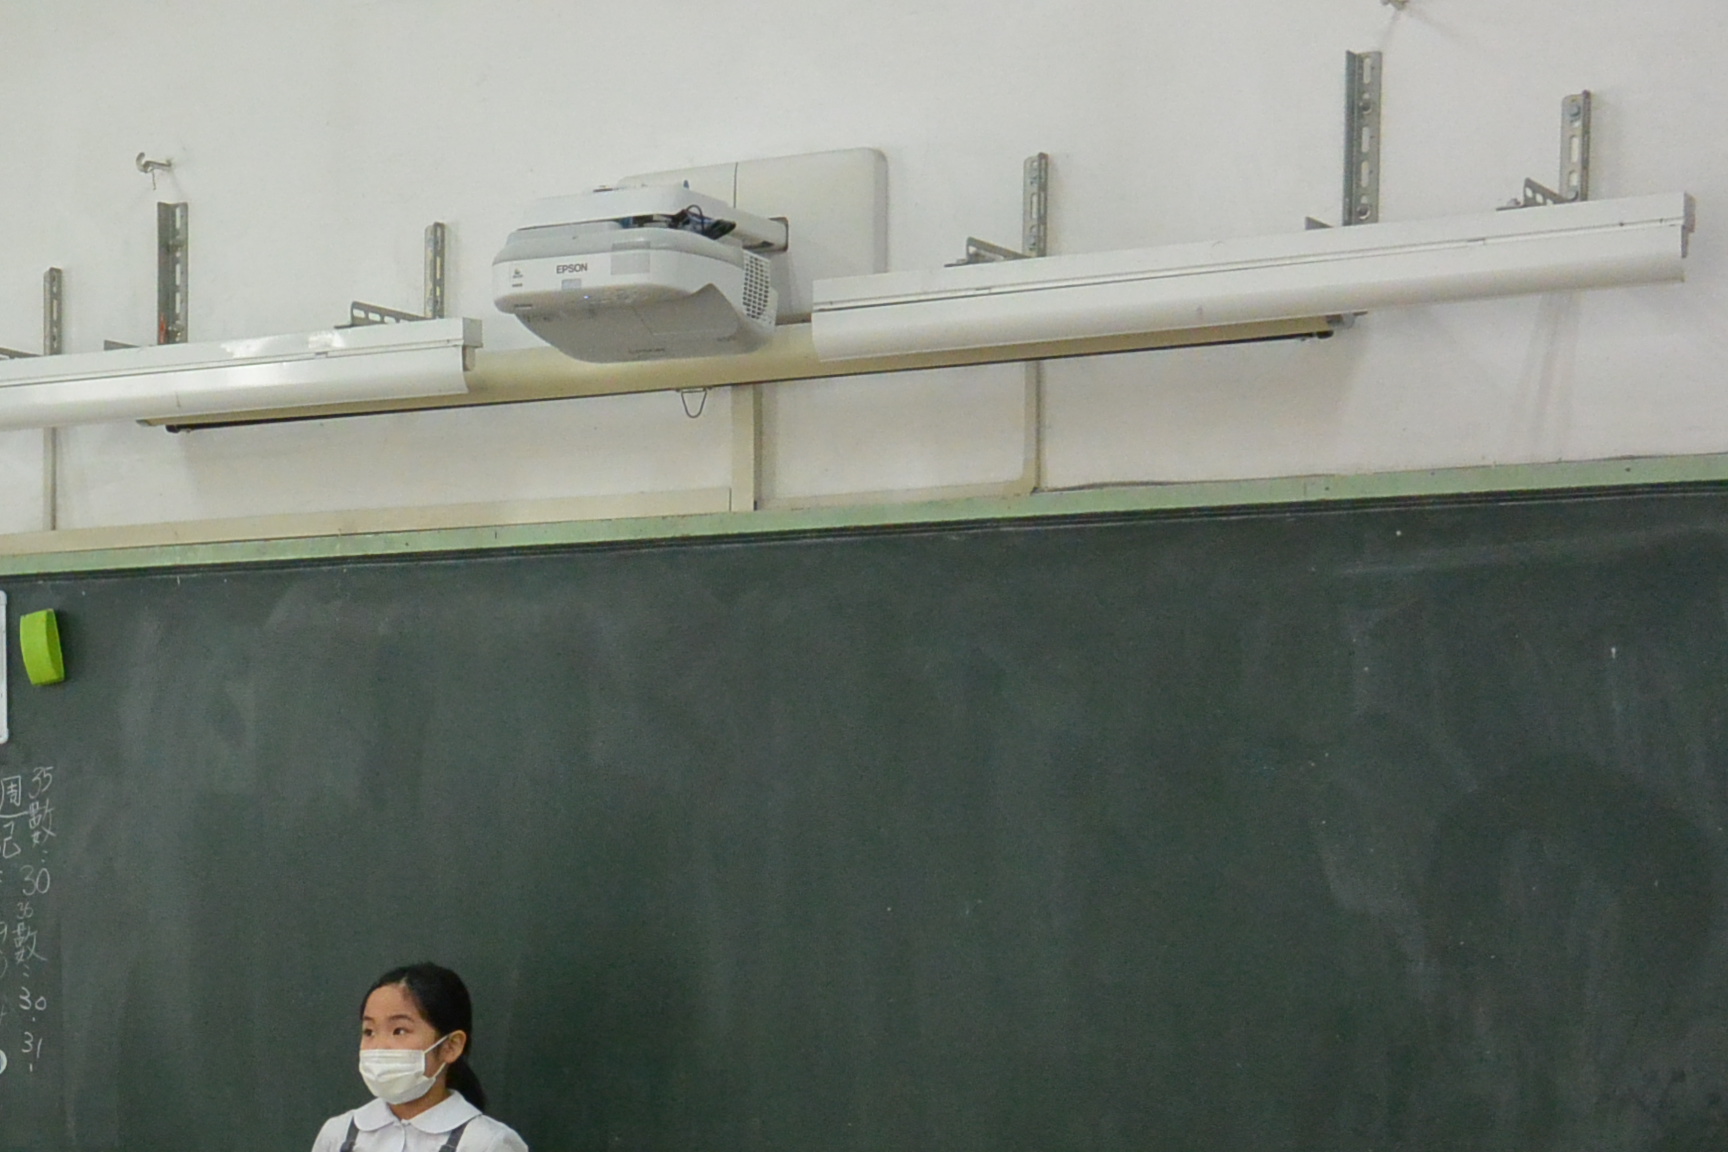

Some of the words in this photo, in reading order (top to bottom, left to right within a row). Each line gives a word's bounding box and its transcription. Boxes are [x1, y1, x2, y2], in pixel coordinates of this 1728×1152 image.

[555, 262, 588, 274] EPSON
[28, 766, 54, 799] 35
[22, 865, 50, 896] 30
[19, 986, 47, 1010] 30
[22, 1031, 42, 1059] 31
